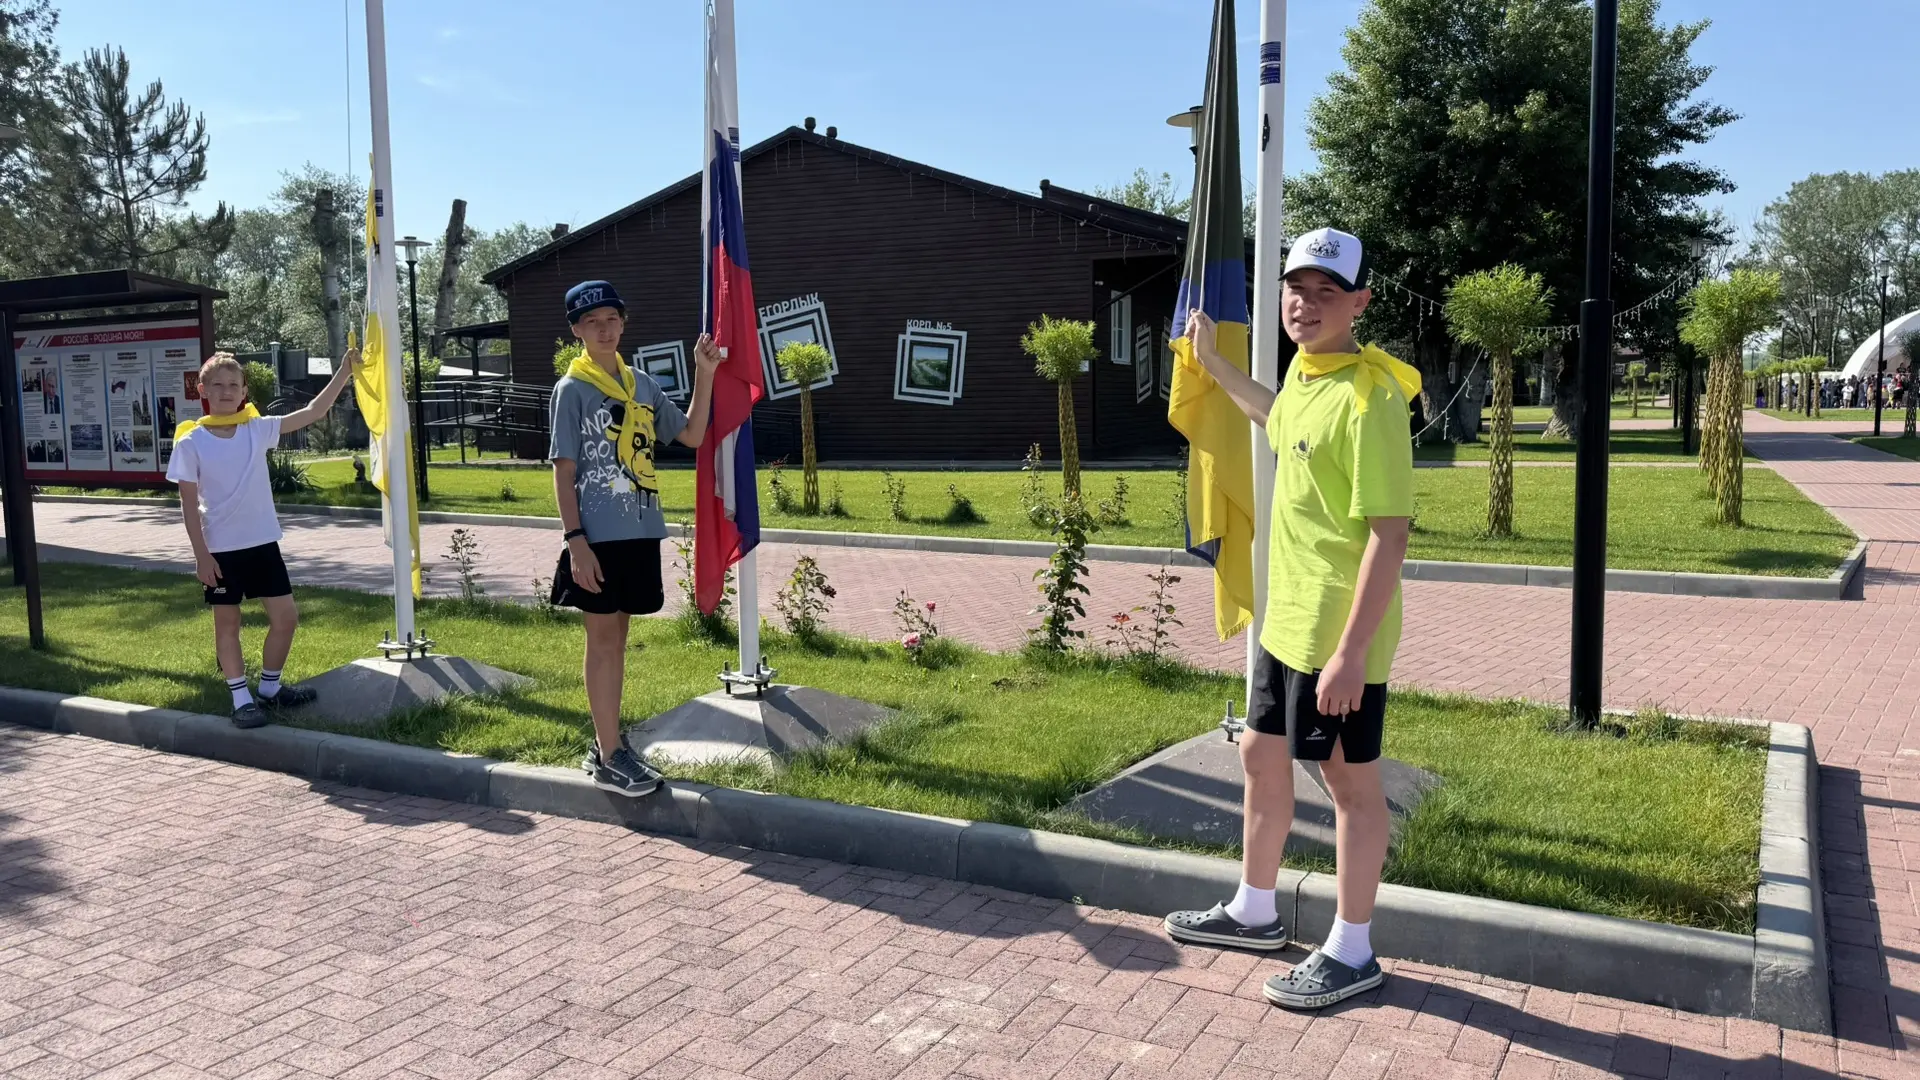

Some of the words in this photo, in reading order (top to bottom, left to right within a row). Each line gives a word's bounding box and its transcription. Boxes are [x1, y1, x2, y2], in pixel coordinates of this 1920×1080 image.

[758, 292, 820, 318] ЕГОРЛЫК
[936, 320, 952, 331] №5
[63, 334, 89, 345] РОССИЯ
[94, 332, 122, 343] РОДИНА
[584, 440, 610, 462] GO
[1304, 991, 1341, 1007] crocs
